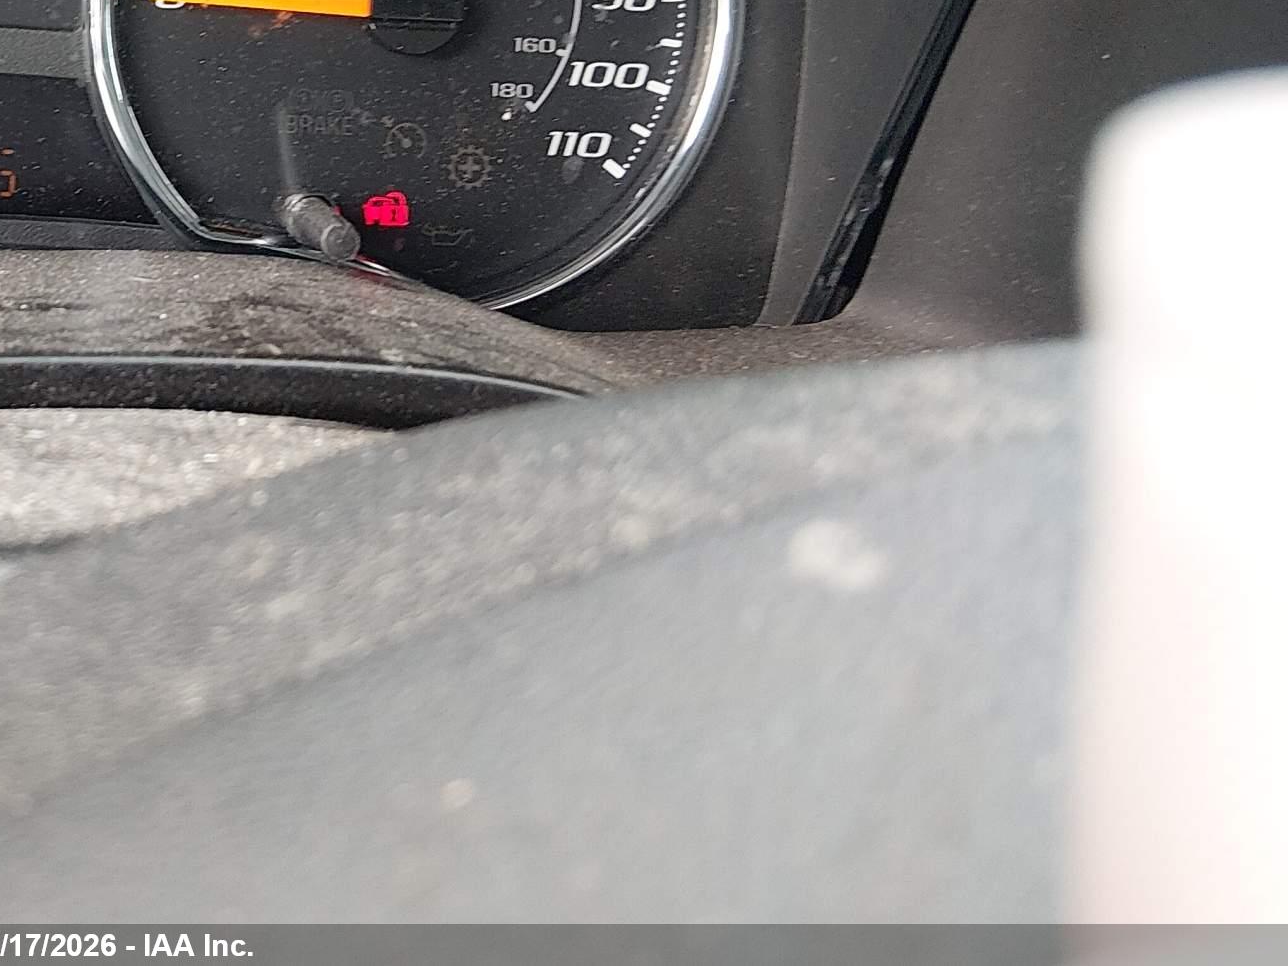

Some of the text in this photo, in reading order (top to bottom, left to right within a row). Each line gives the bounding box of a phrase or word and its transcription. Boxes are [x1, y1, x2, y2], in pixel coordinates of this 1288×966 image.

[513, 37, 558, 54] 160
[567, 60, 649, 88] 100
[490, 82, 534, 99] 180
[546, 131, 614, 158] 110
